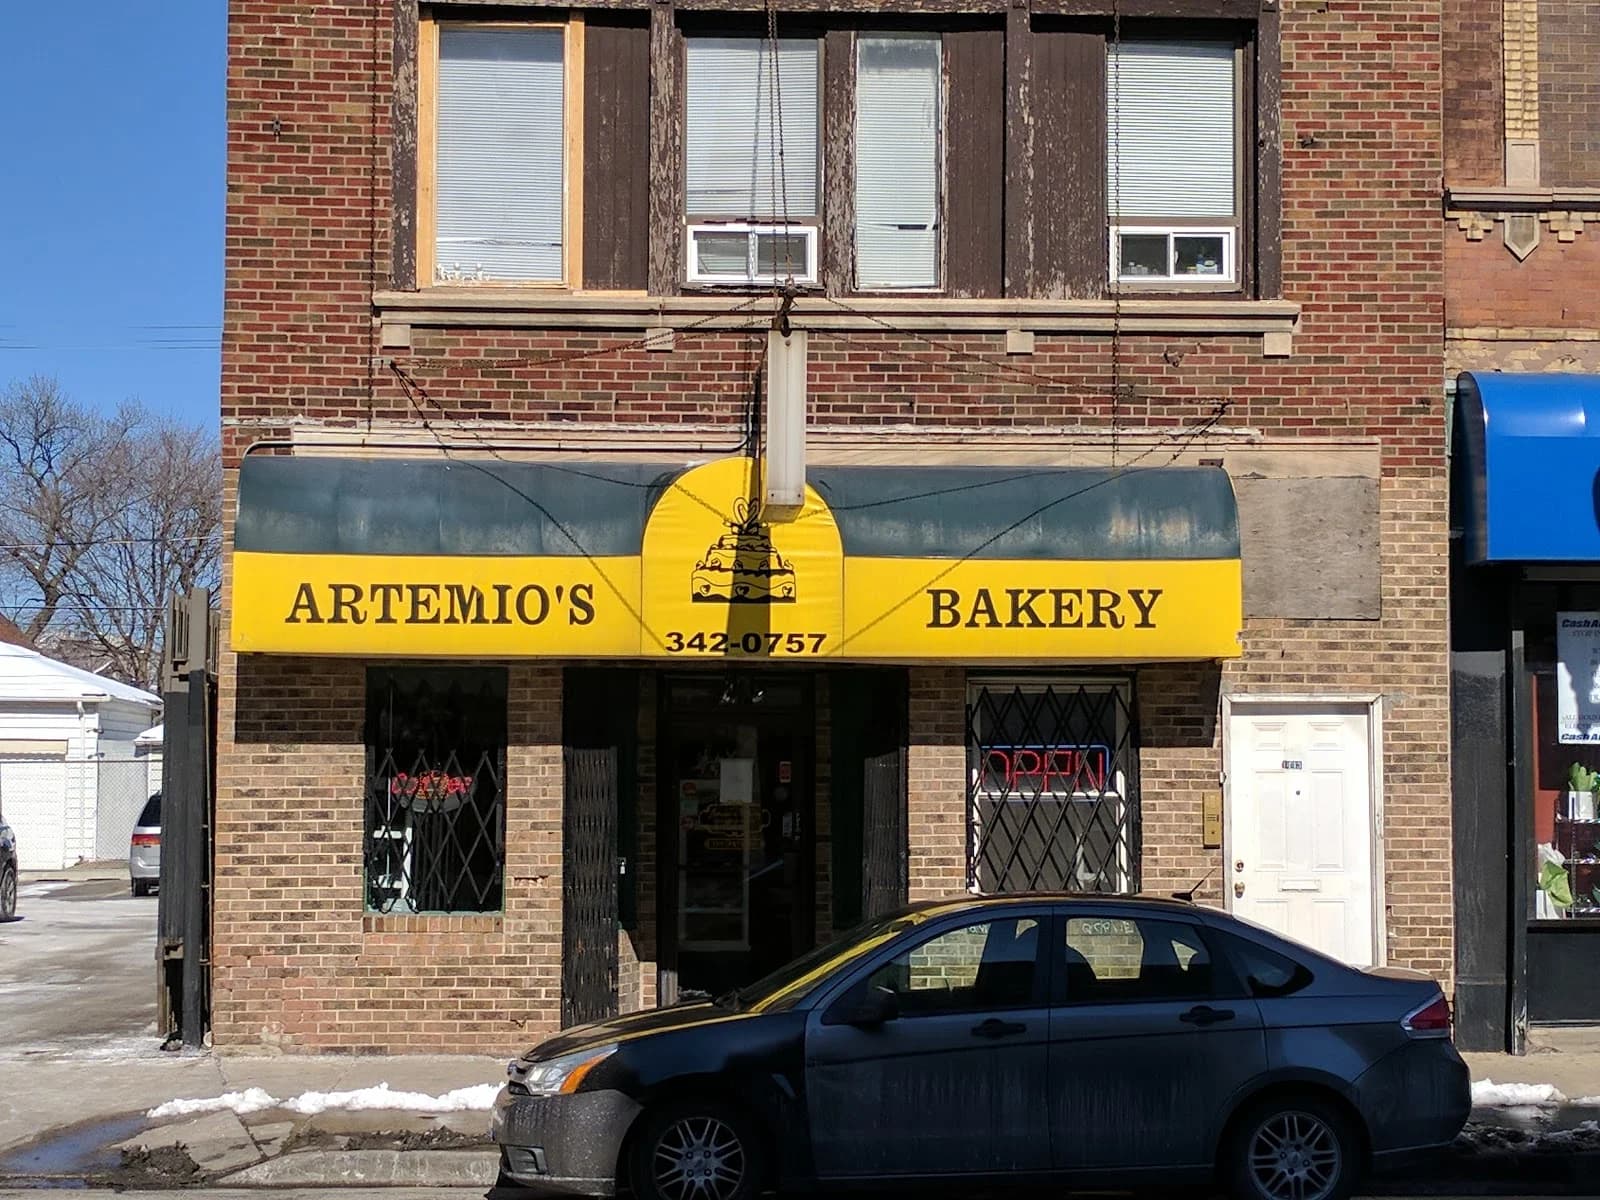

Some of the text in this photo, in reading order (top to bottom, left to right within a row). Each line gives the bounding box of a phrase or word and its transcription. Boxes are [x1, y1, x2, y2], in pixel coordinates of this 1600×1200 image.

[284, 582, 596, 626] ARTEMIO'S
[926, 588, 1164, 629] BAKERY
[1561, 618, 1591, 628] Cash
[665, 631, 828, 654] 342-0757
[1561, 733, 1590, 741] Cash
[981, 750, 1105, 793] OPEN
